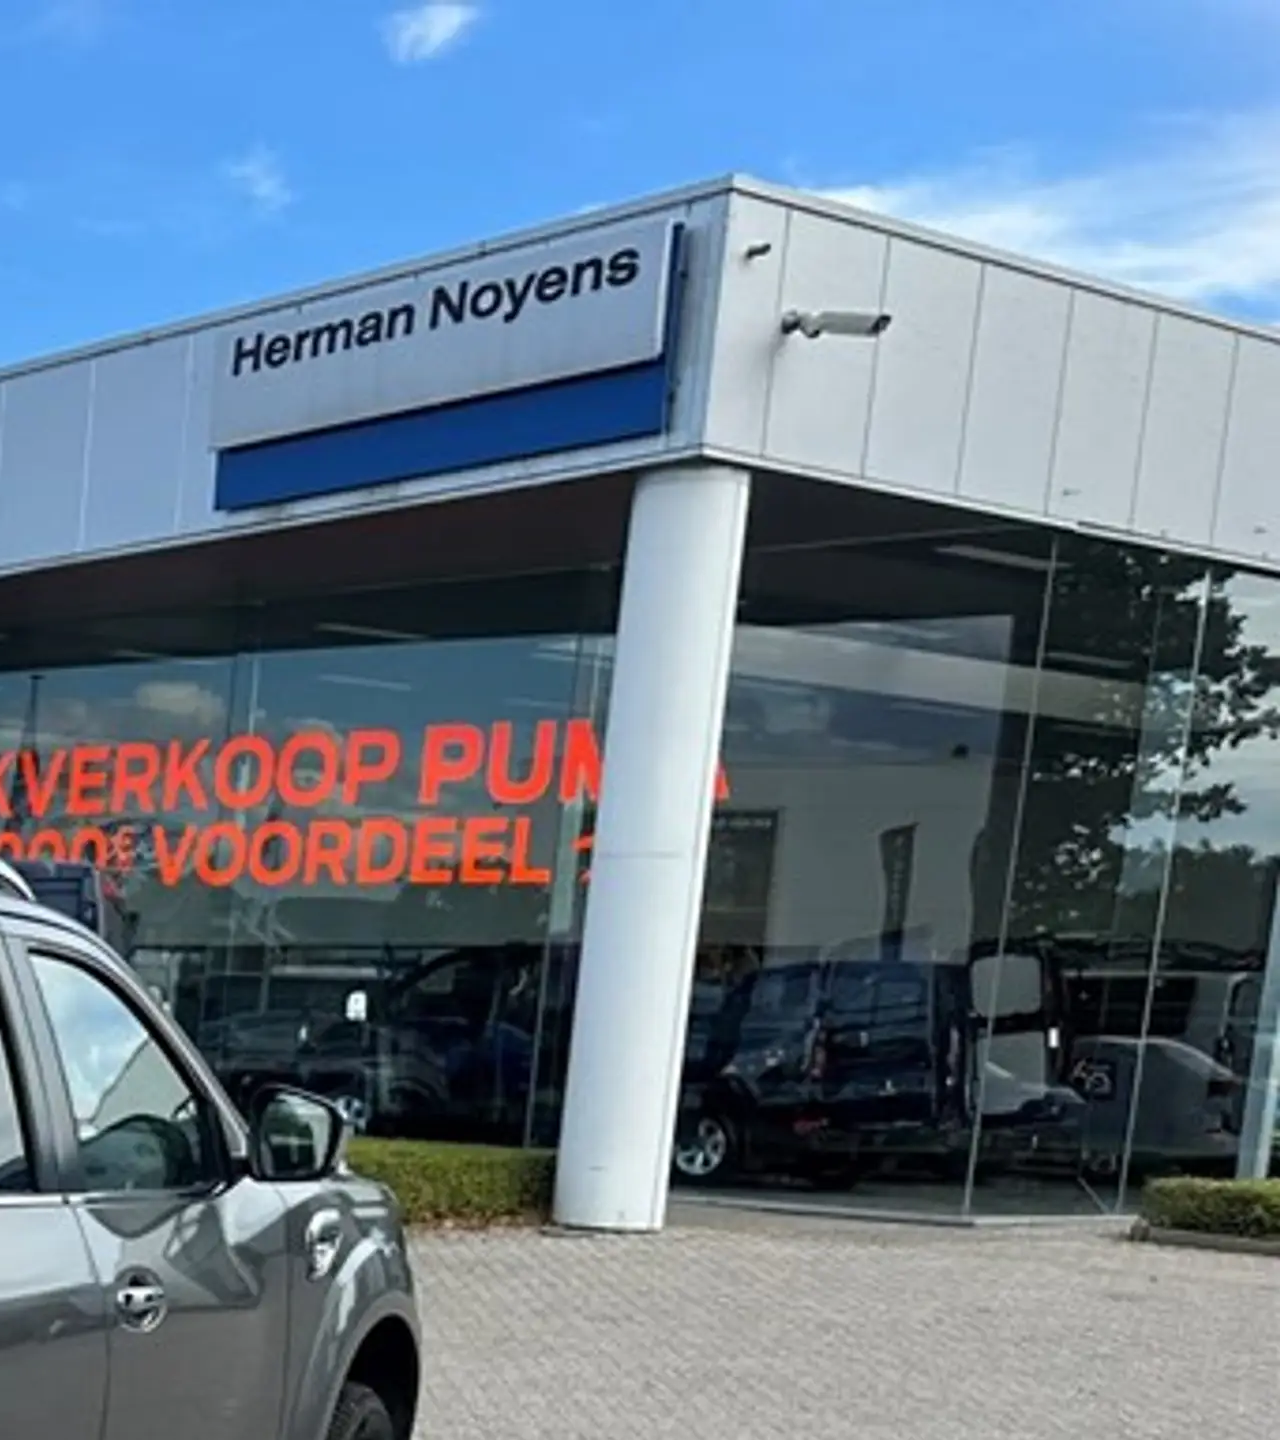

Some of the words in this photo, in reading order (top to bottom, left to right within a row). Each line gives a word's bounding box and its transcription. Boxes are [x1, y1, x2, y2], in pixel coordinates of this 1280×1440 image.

[231, 302, 414, 376] Herman
[429, 247, 640, 331] Noyens
[153, 815, 552, 886] VOORDEEL
